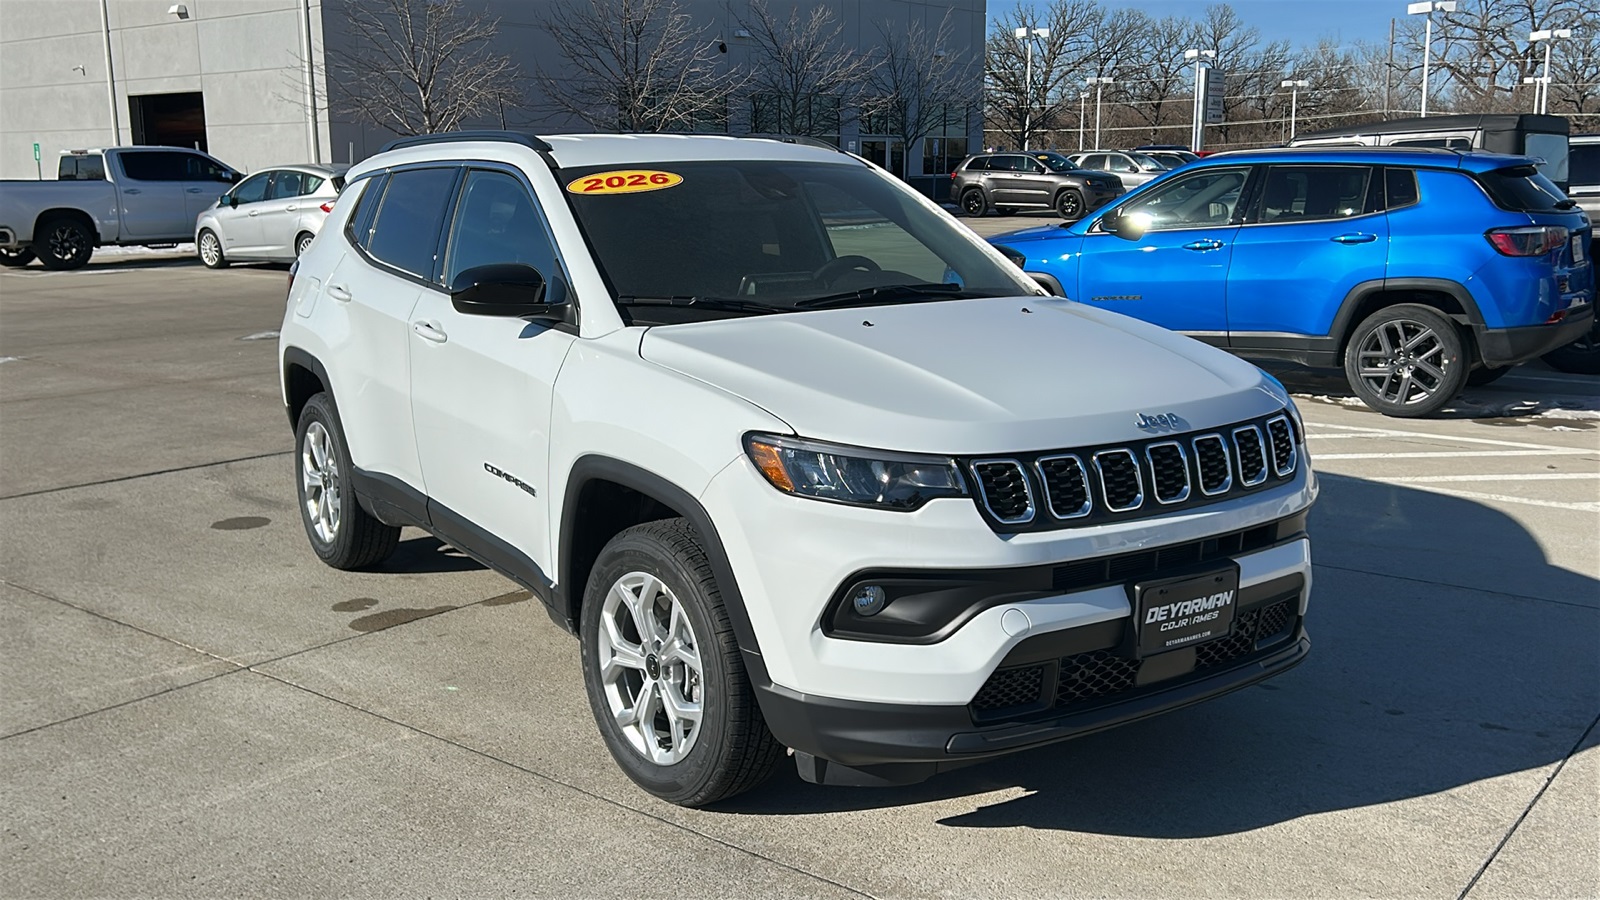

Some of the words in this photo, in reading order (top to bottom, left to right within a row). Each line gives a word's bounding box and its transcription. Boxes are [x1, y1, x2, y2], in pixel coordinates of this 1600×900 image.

[583, 173, 670, 192] 2026
[1134, 412, 1179, 430] Jeep
[1145, 590, 1234, 624] DEYARMAN
[1192, 610, 1219, 624] AMES
